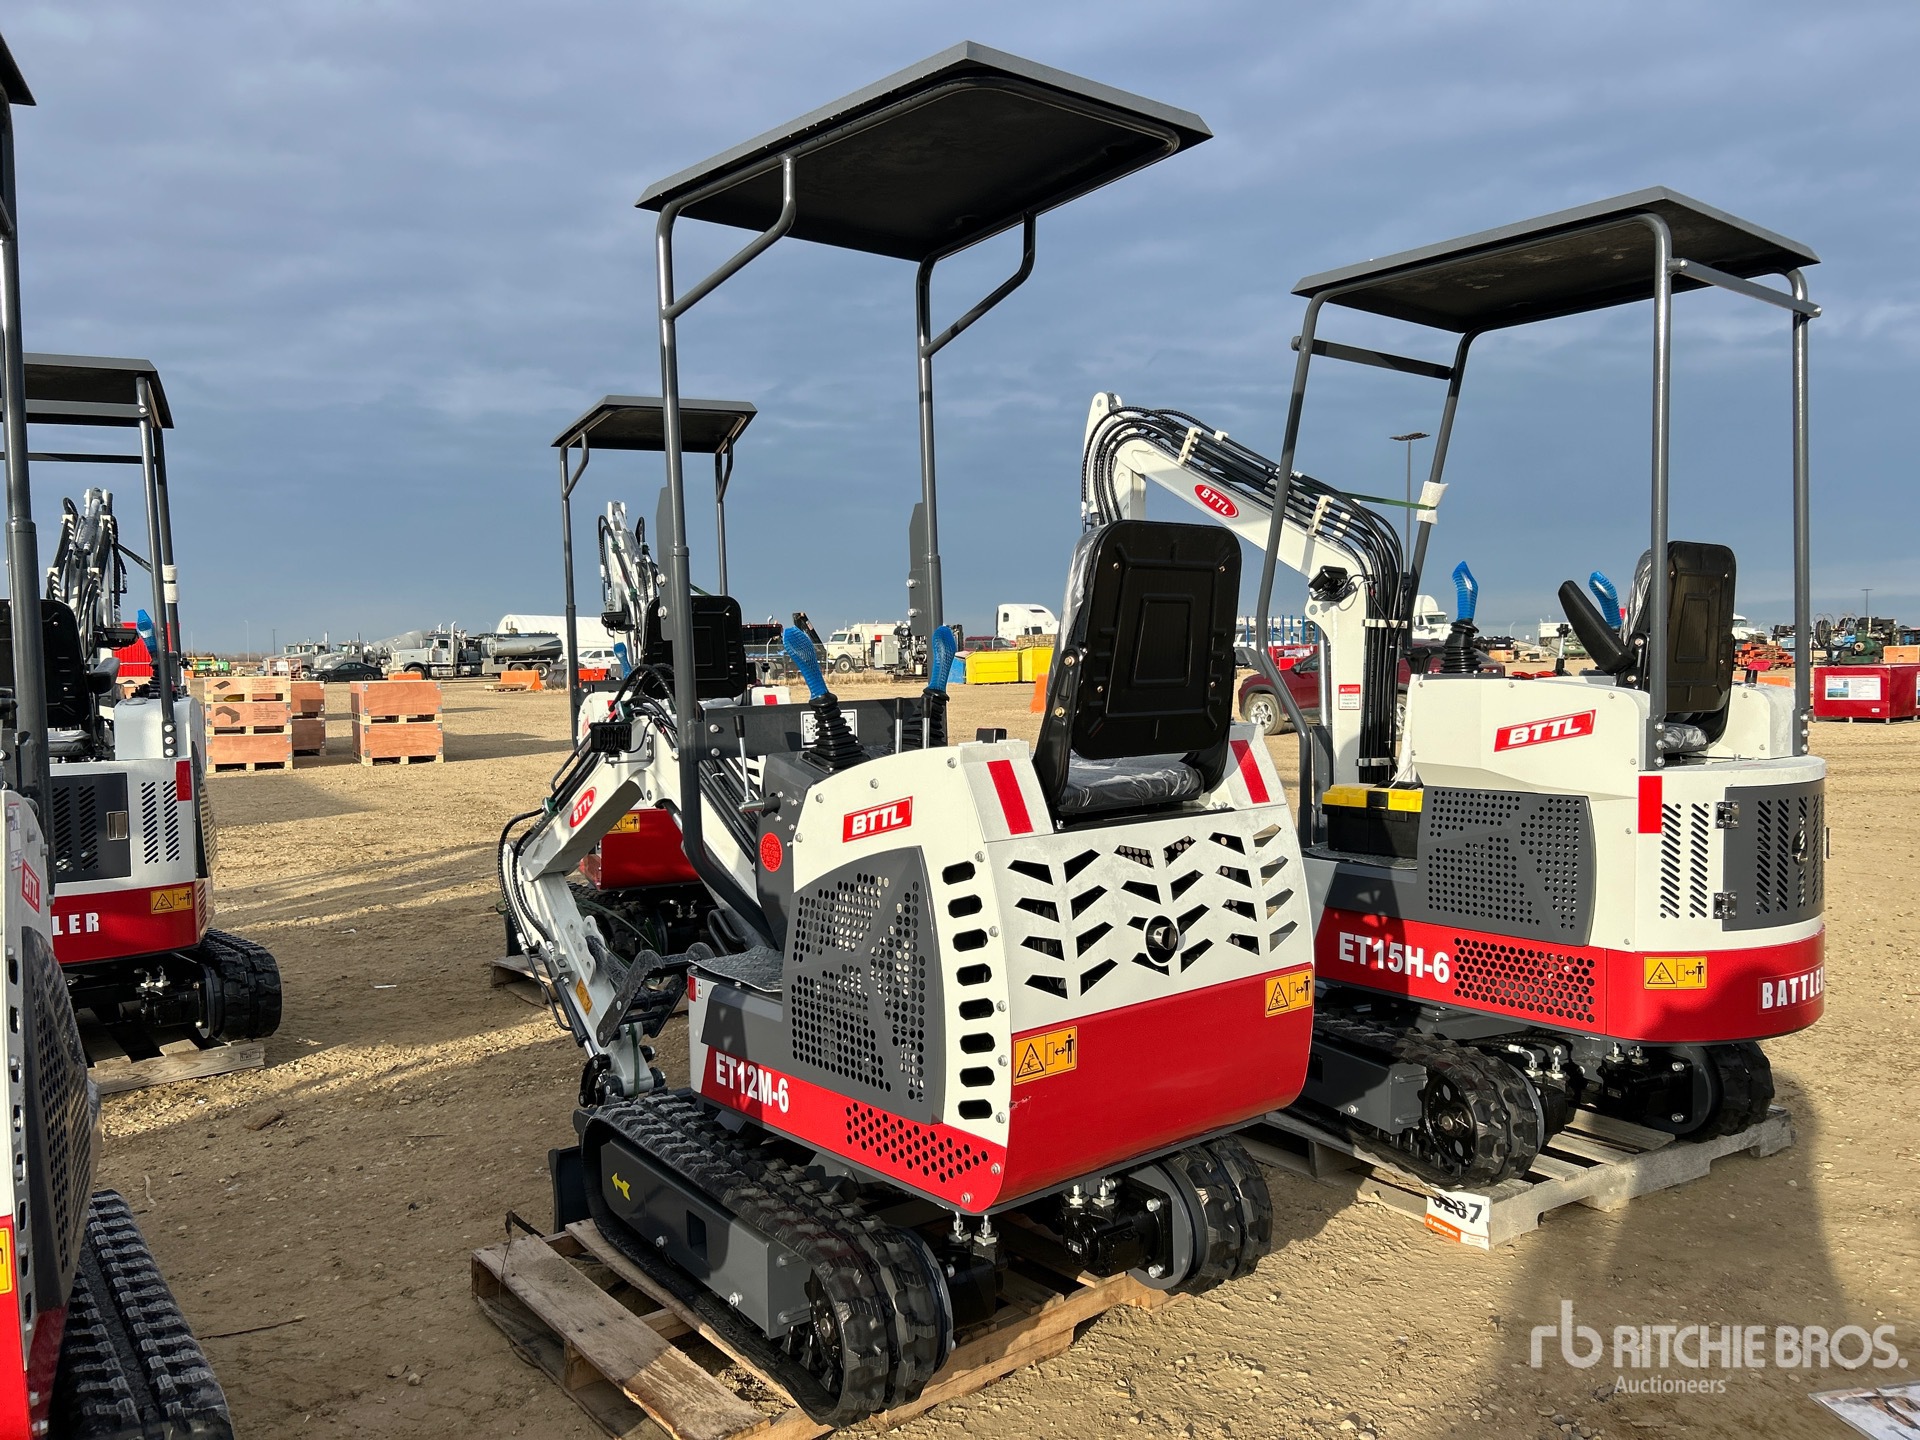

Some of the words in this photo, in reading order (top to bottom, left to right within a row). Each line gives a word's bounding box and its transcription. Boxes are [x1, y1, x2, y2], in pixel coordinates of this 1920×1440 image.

[1200, 488, 1229, 515] BTTL
[1508, 717, 1582, 746] BTTL
[573, 793, 594, 823] BTTL
[851, 804, 904, 836] BTTL
[24, 867, 39, 905] BTTL
[1339, 931, 1450, 984] ET15H-6
[715, 1051, 790, 1113] ET12M-6
